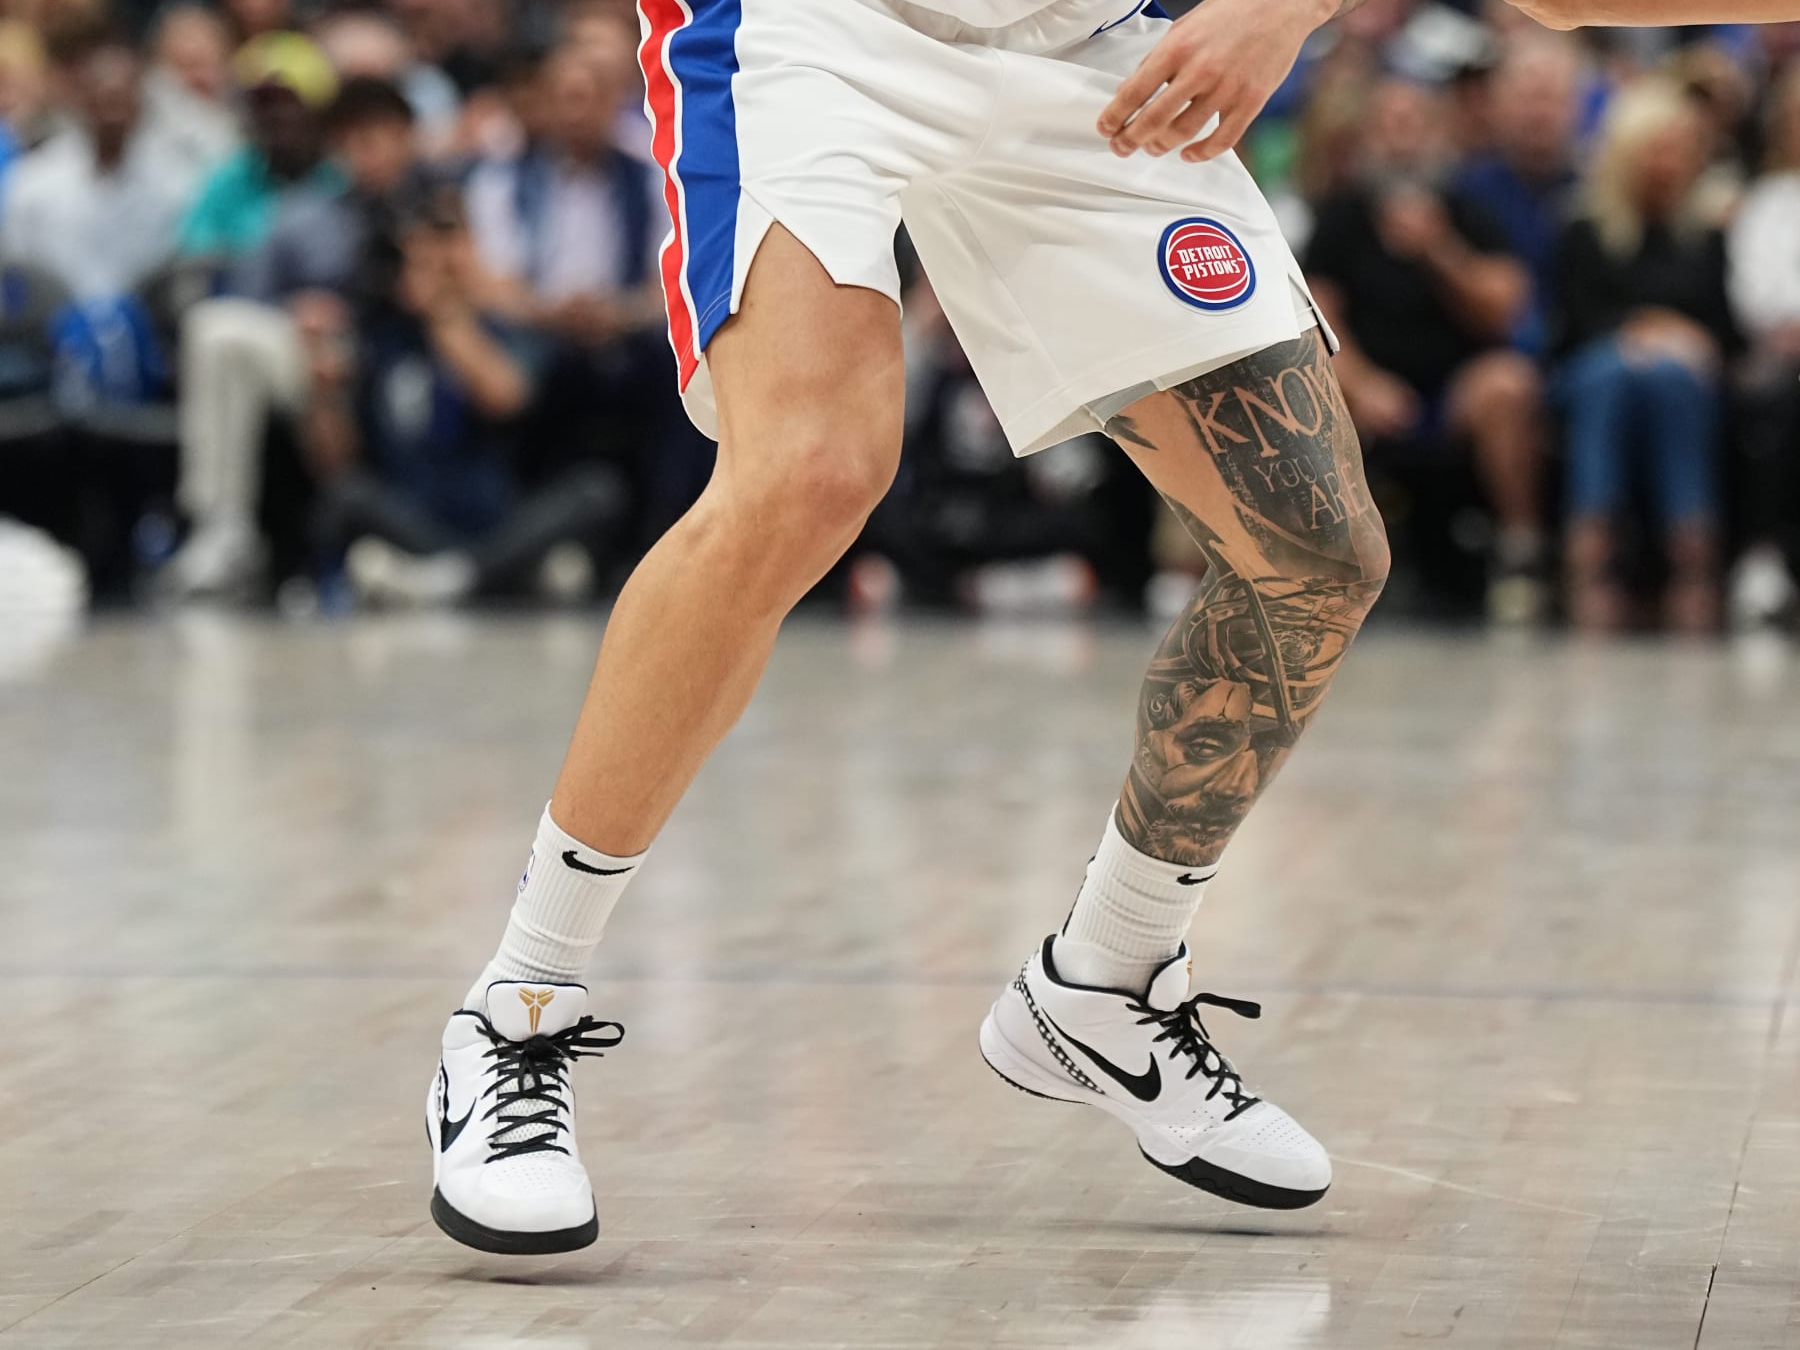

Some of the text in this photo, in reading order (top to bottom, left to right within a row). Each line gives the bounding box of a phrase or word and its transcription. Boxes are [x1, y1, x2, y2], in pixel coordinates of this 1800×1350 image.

[1177, 245, 1233, 264] DETROIT
[1182, 260, 1241, 281] PISTONS
[1252, 455, 1318, 493] YOU
[1309, 459, 1369, 531] ARE
